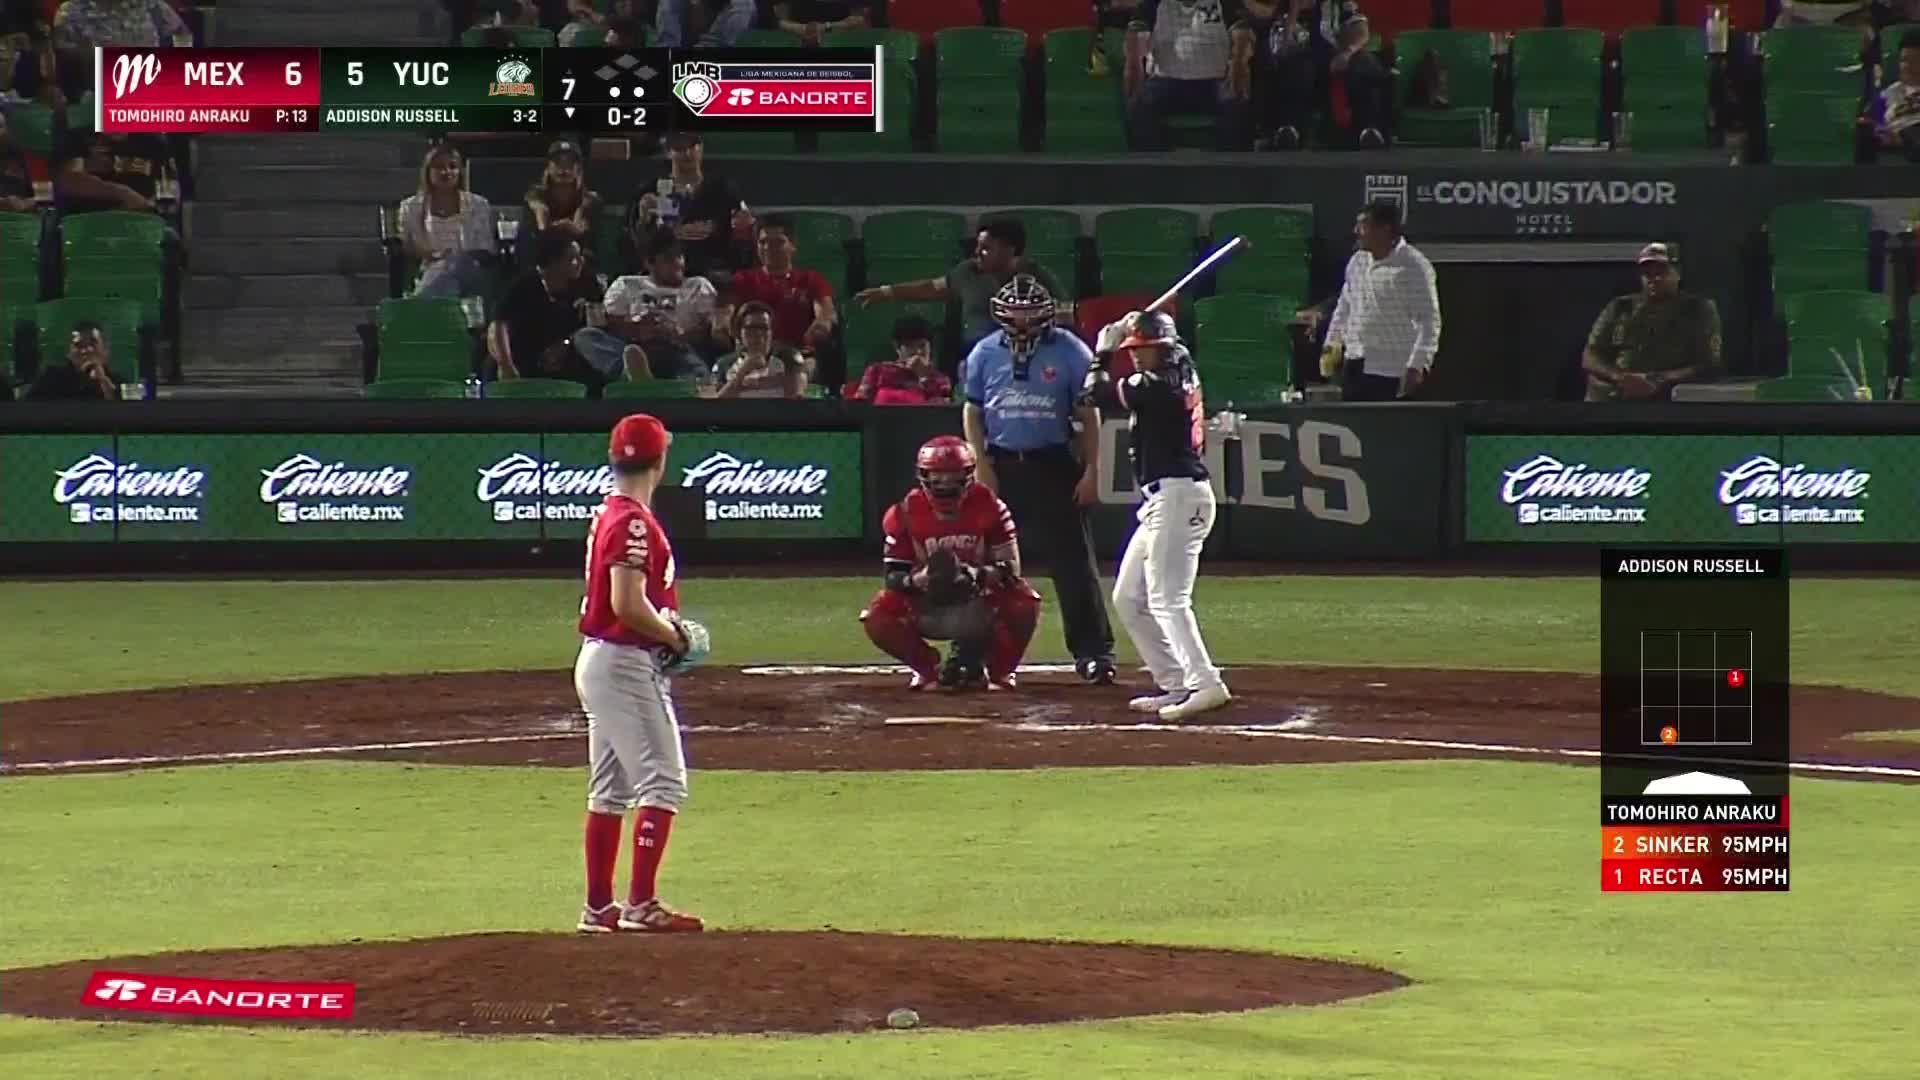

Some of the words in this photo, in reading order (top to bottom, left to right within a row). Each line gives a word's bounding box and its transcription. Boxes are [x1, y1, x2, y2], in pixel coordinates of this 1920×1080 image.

[1433, 180, 1677, 208] CONQUISTADOR
[1516, 214, 1573, 225] HOTEL
[53, 454, 205, 504] Caliente
[260, 453, 410, 503] Caliente
[1502, 455, 1652, 504] Caliente
[1718, 455, 1872, 505] Caliente
[298, 503, 404, 521] caliente.mx
[718, 501, 823, 519] caliente.mx
[1540, 504, 1646, 523] caliente.mx
[151, 987, 343, 1009] BANORTE
